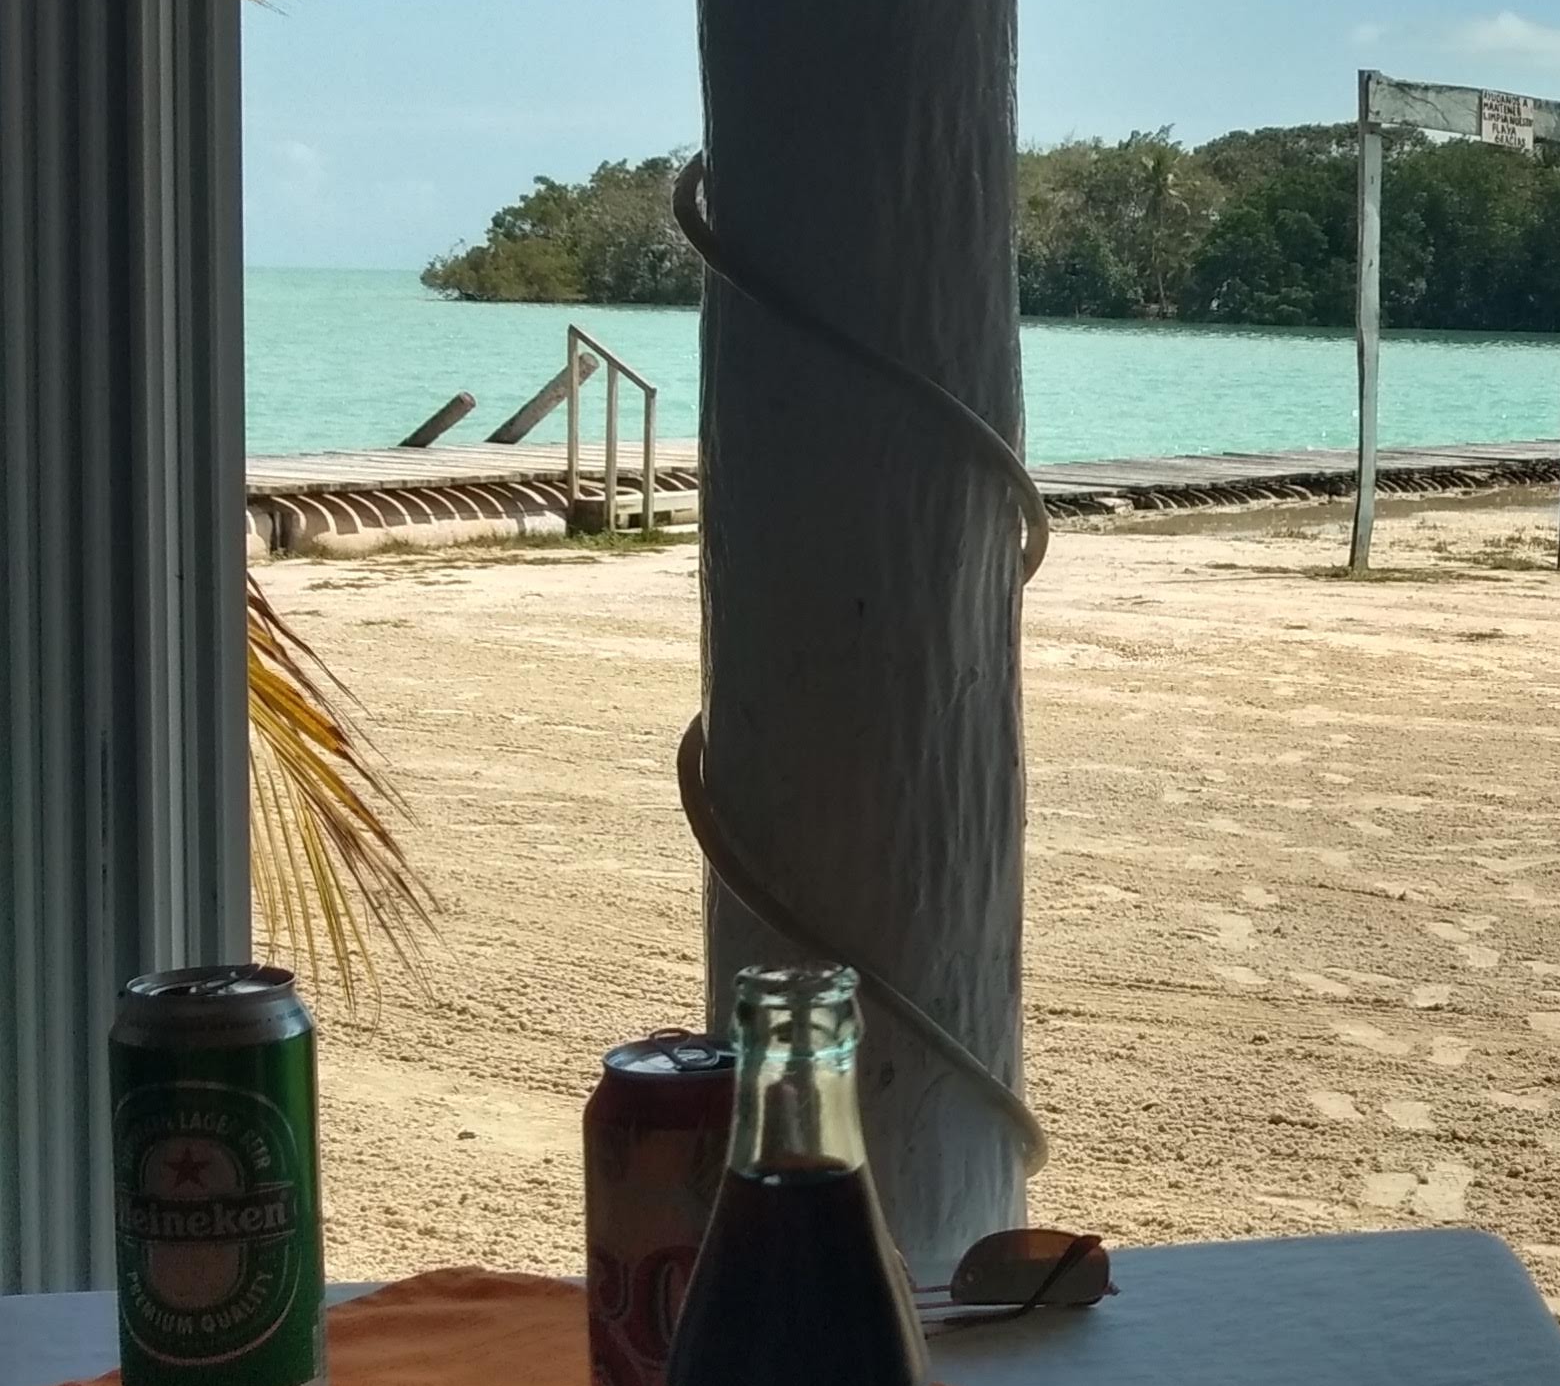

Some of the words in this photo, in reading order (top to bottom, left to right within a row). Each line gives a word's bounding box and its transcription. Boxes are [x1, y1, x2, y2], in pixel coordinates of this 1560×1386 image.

[1522, 98, 1528, 108] A
[1492, 123, 1516, 135] PLAYA
[127, 1270, 193, 1335] PREMIUM
[200, 1269, 274, 1333] QUALITY
